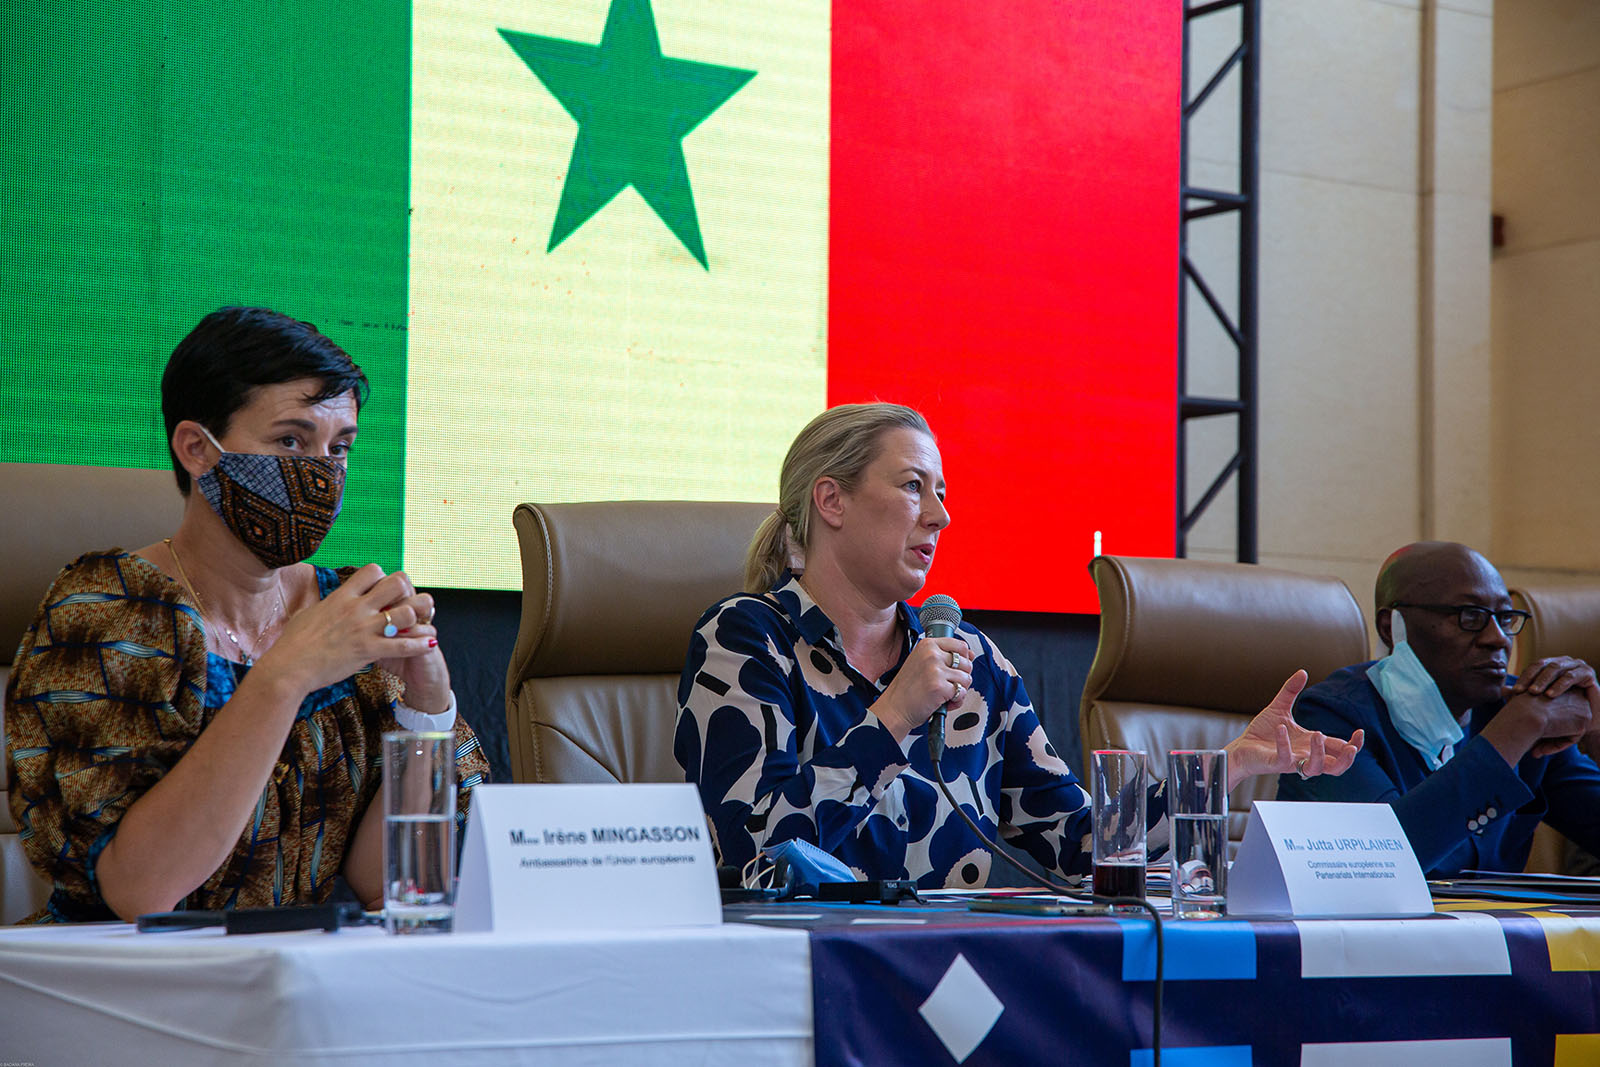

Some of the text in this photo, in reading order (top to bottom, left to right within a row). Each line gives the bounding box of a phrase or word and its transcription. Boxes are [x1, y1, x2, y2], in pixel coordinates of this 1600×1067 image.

[543, 829, 587, 845] Irène
[592, 826, 700, 843] MINGASSON
[1307, 839, 1334, 851] Jutta
[1335, 839, 1404, 851] URPILAINEN
[1307, 861, 1348, 869] Commissaire
[1315, 871, 1396, 879] Partenariats Internationaux
